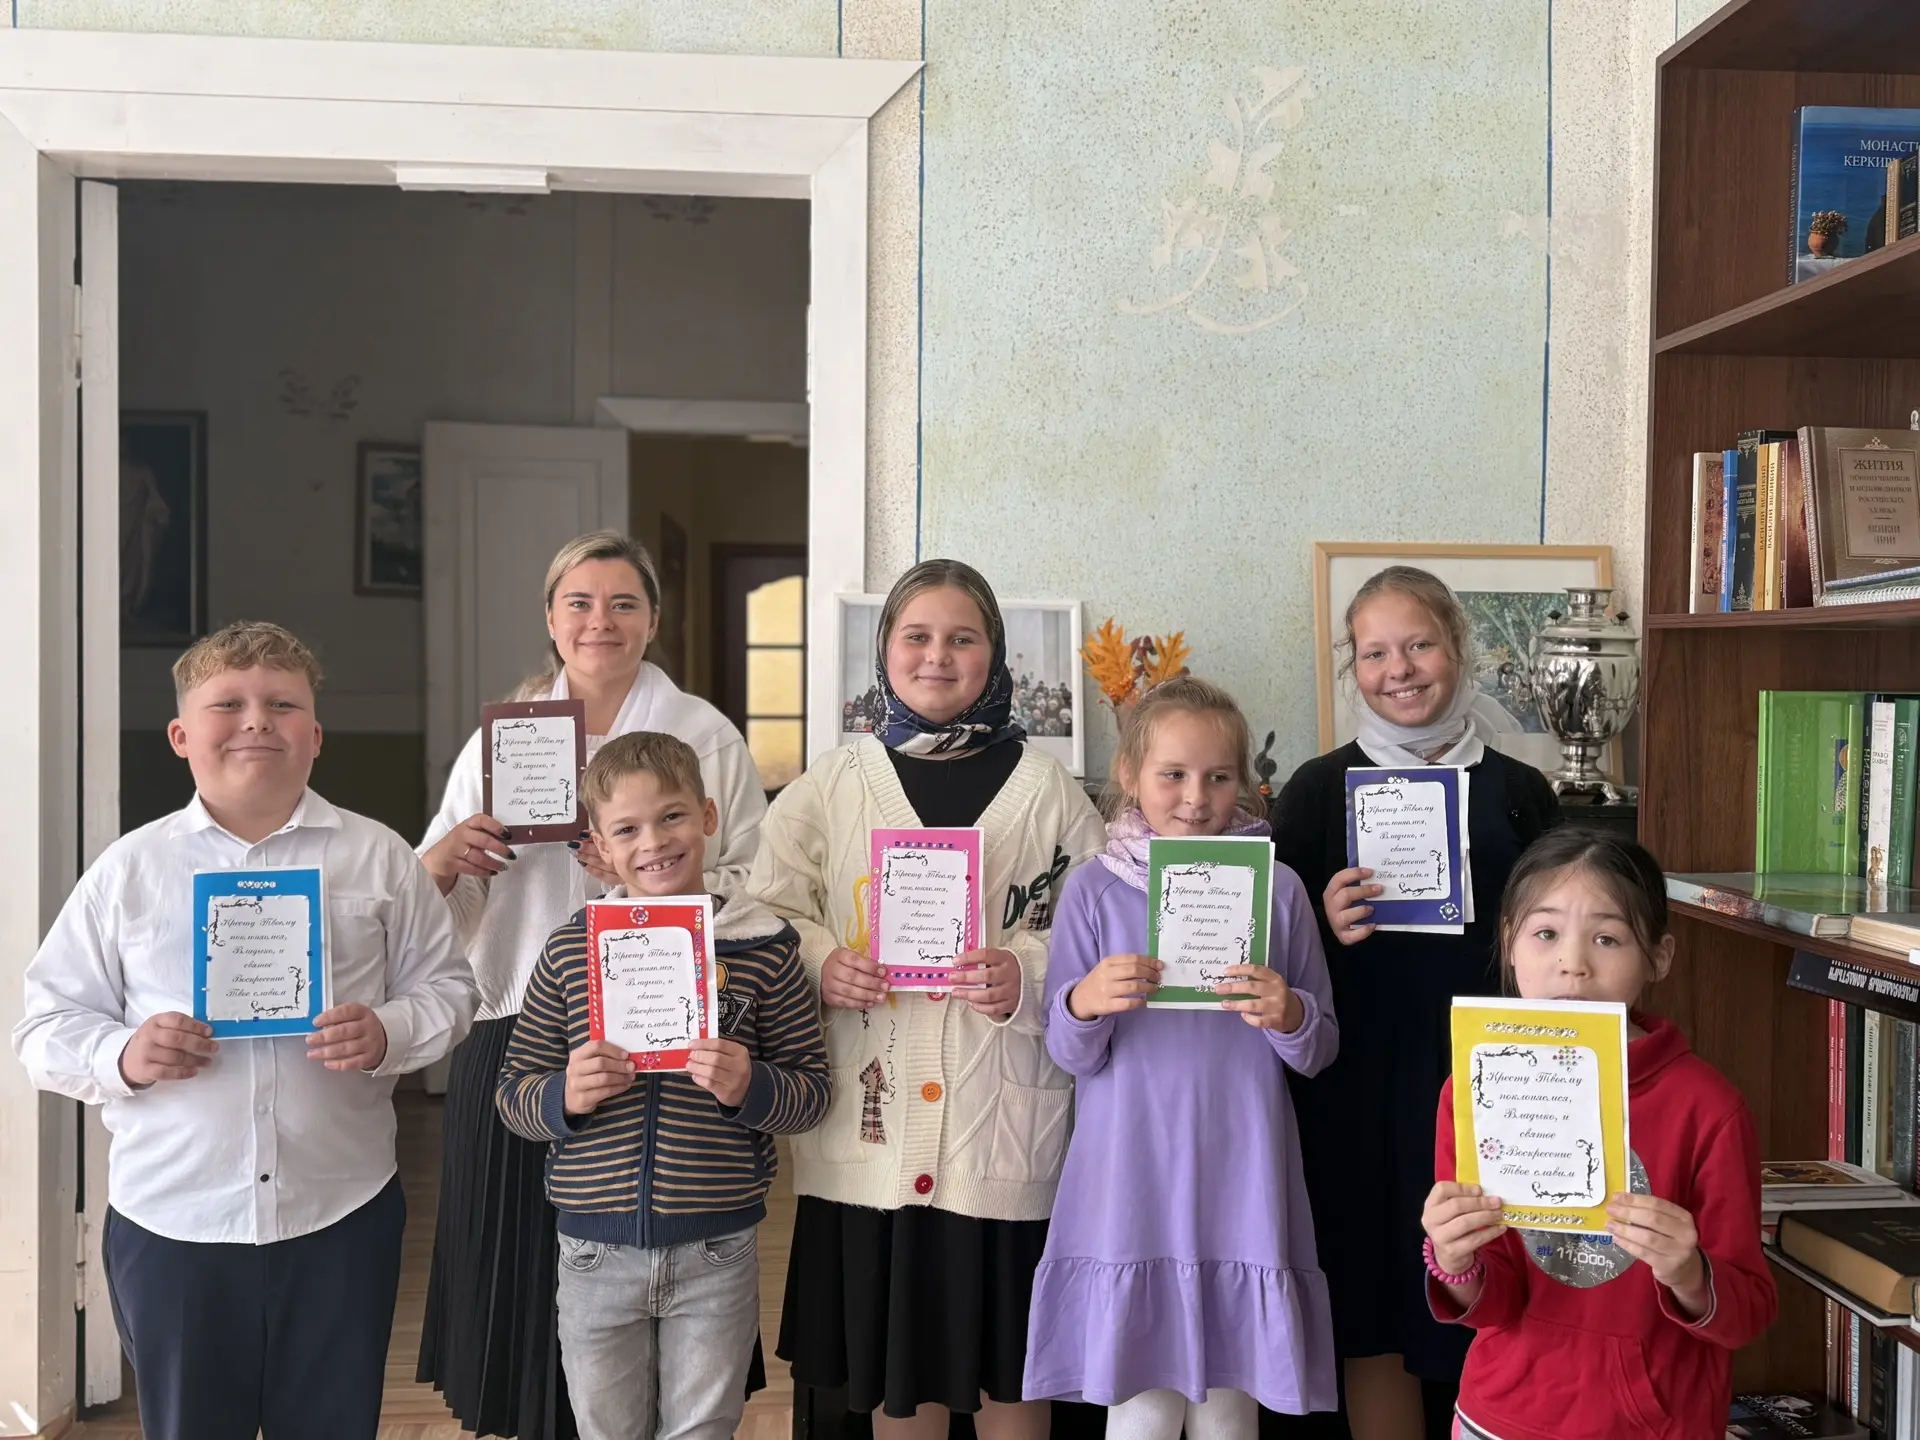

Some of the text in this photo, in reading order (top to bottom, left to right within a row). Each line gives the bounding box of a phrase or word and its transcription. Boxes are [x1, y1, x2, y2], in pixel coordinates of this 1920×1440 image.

[1844, 155, 1902, 168] КЕРКИР
[1853, 459, 1904, 471] ЖИТИЯ
[1827, 966, 1867, 988] МОНАСТЫРИ
[1486, 1071, 1583, 1086] Кресту Твоему
[1499, 1094, 1572, 1104] поклоняемся,
[1503, 1109, 1558, 1122] Владыко,
[1519, 1130, 1556, 1139] святое
[1506, 1147, 1572, 1160] Воскресение
[1500, 1164, 1575, 1177] Твое славим
